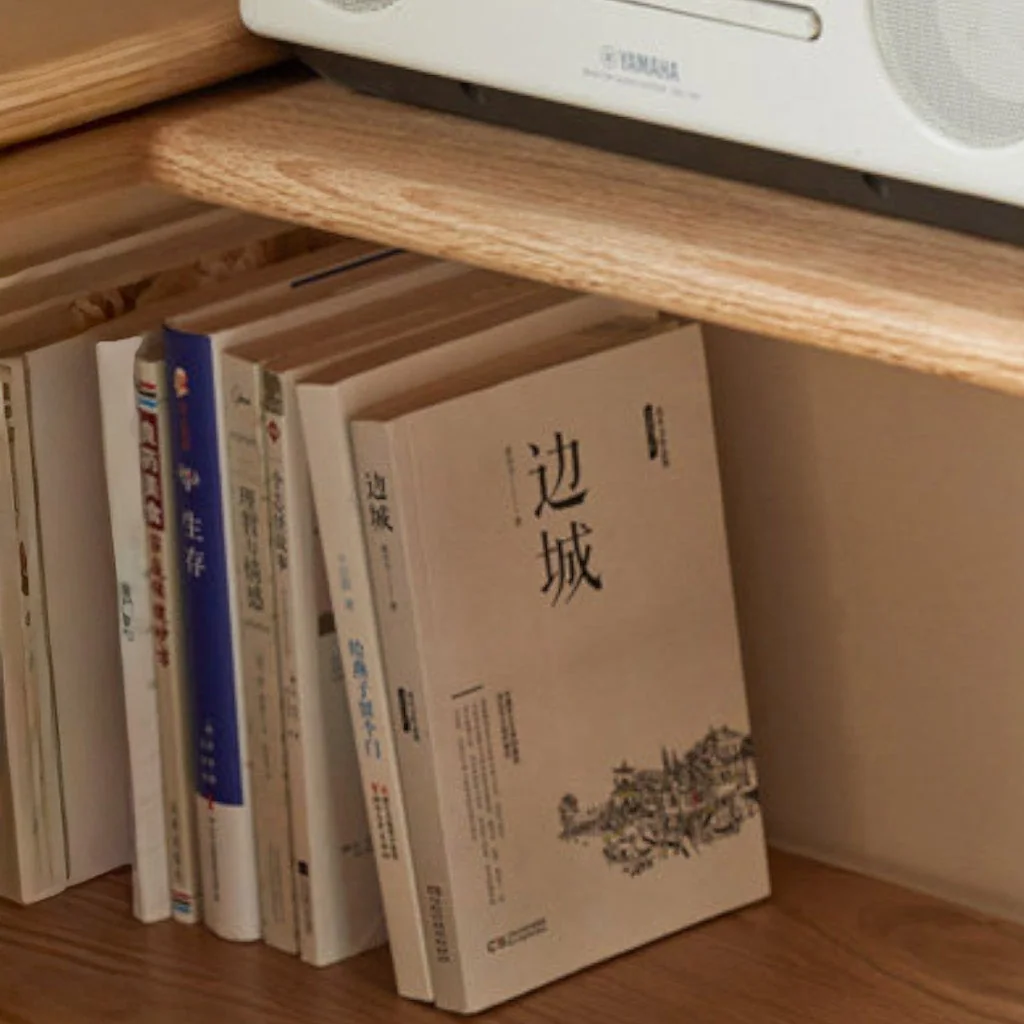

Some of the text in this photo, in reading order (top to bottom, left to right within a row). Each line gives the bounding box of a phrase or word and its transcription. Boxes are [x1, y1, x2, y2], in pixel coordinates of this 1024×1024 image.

[620, 51, 680, 82] YAMAHA
[365, 472, 394, 533] 边城
[528, 430, 603, 608] 边城
